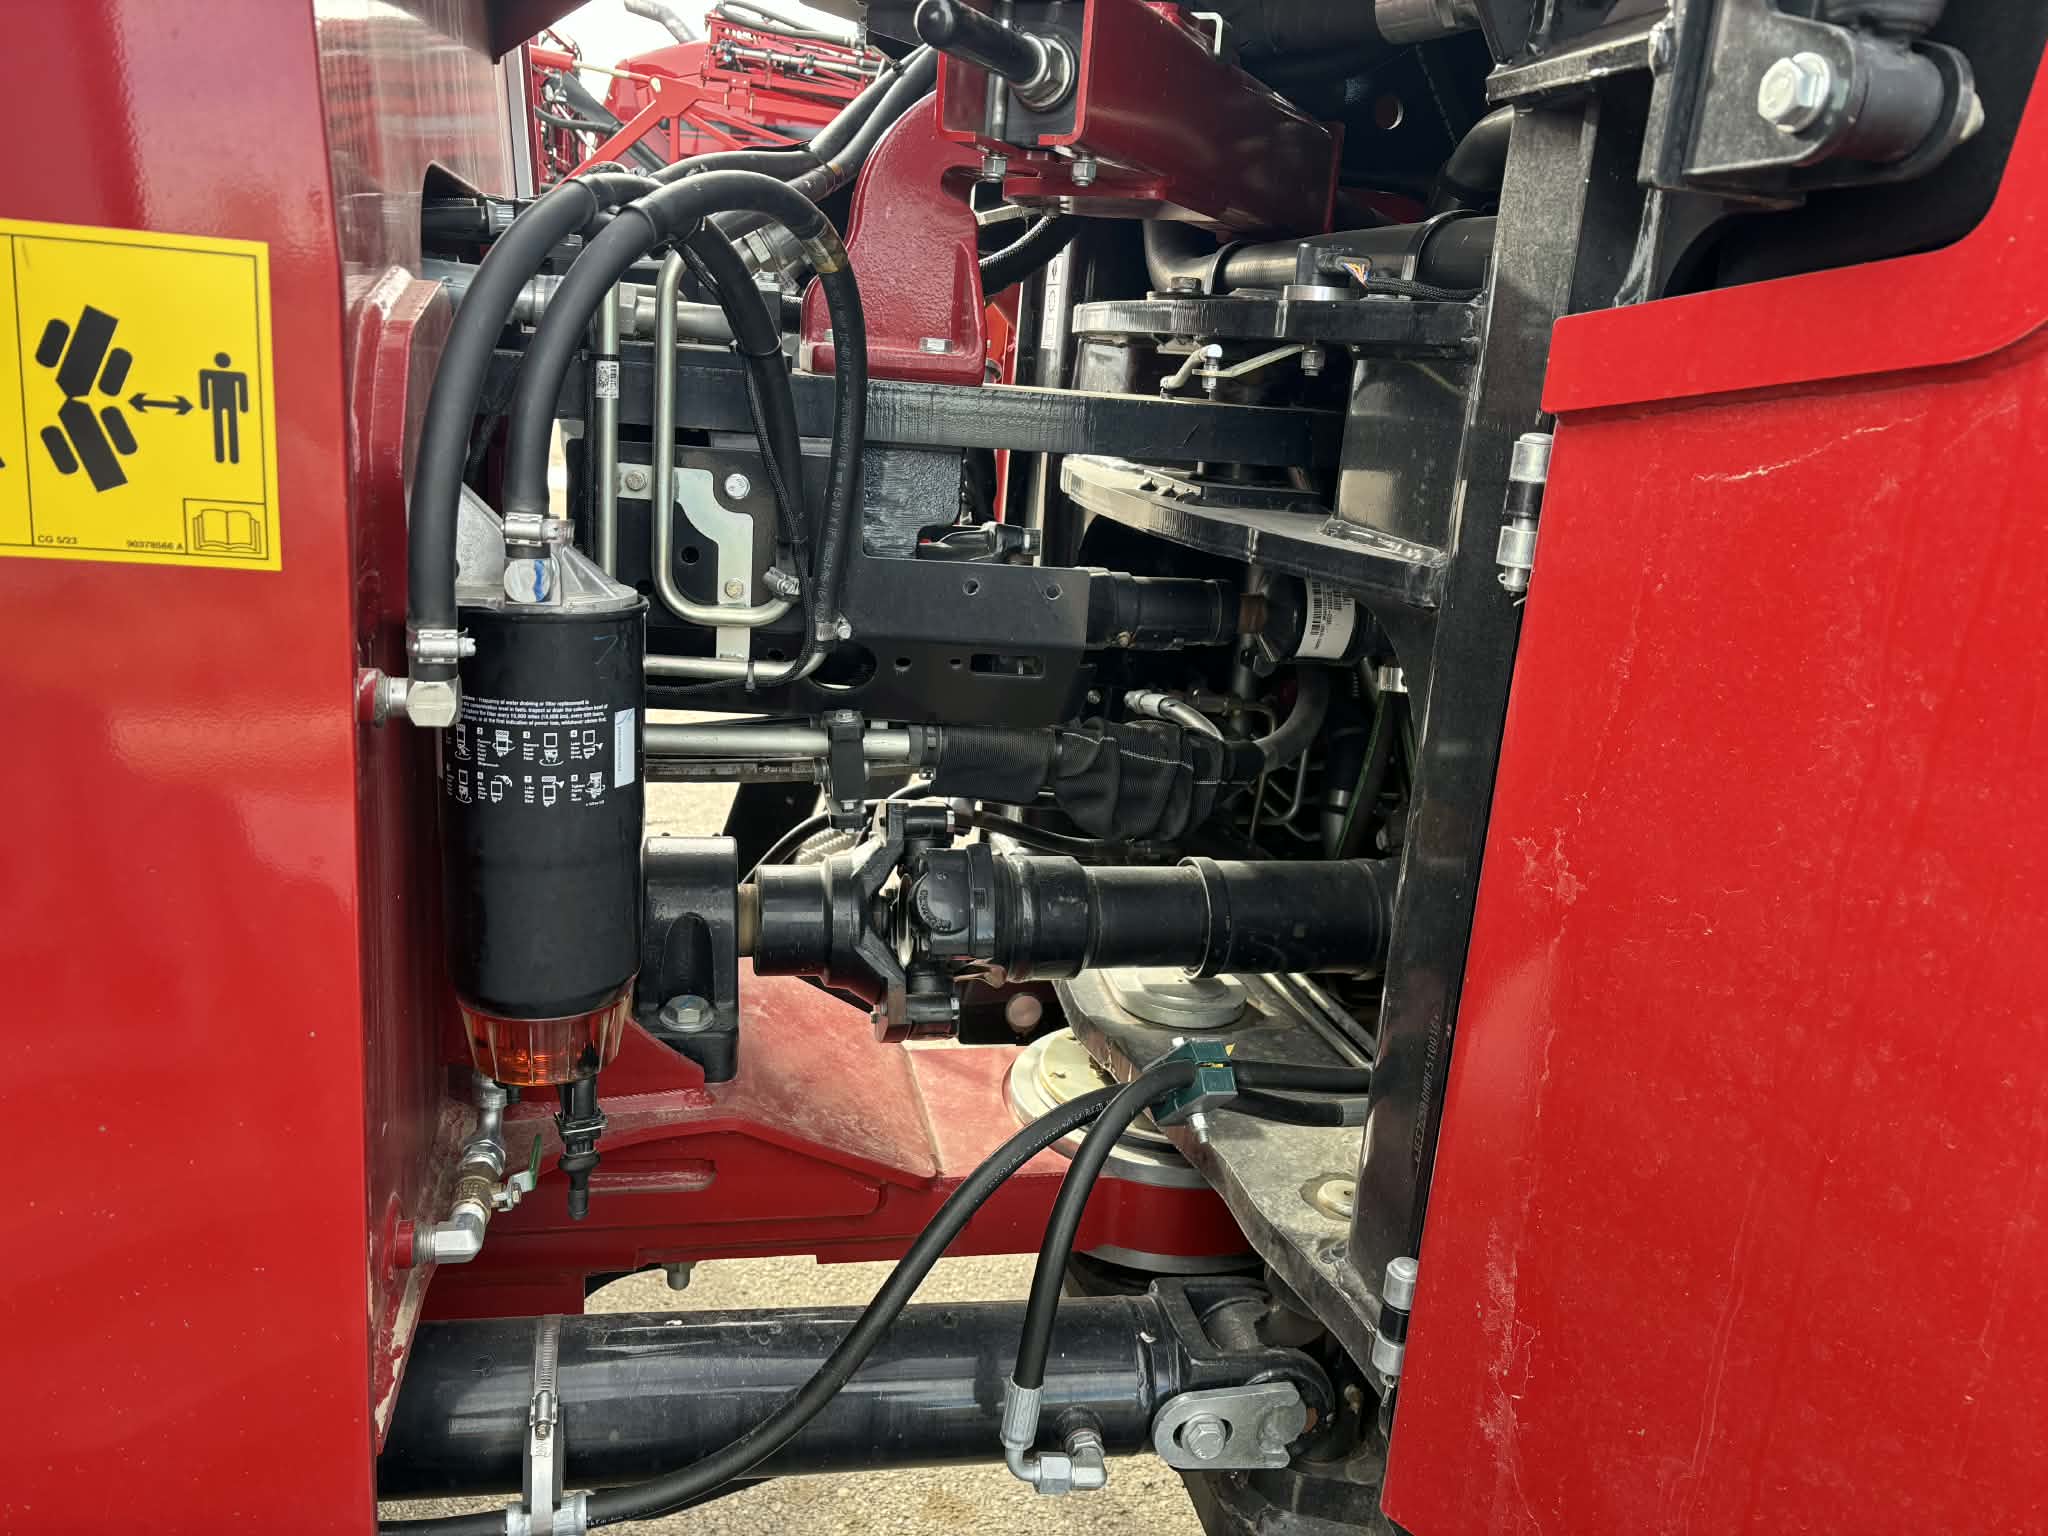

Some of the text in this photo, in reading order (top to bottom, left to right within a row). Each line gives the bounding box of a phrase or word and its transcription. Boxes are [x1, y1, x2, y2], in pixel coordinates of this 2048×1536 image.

[38, 535, 54, 544] CG
[57, 536, 77, 545] 5/23
[177, 543, 184, 551] A
